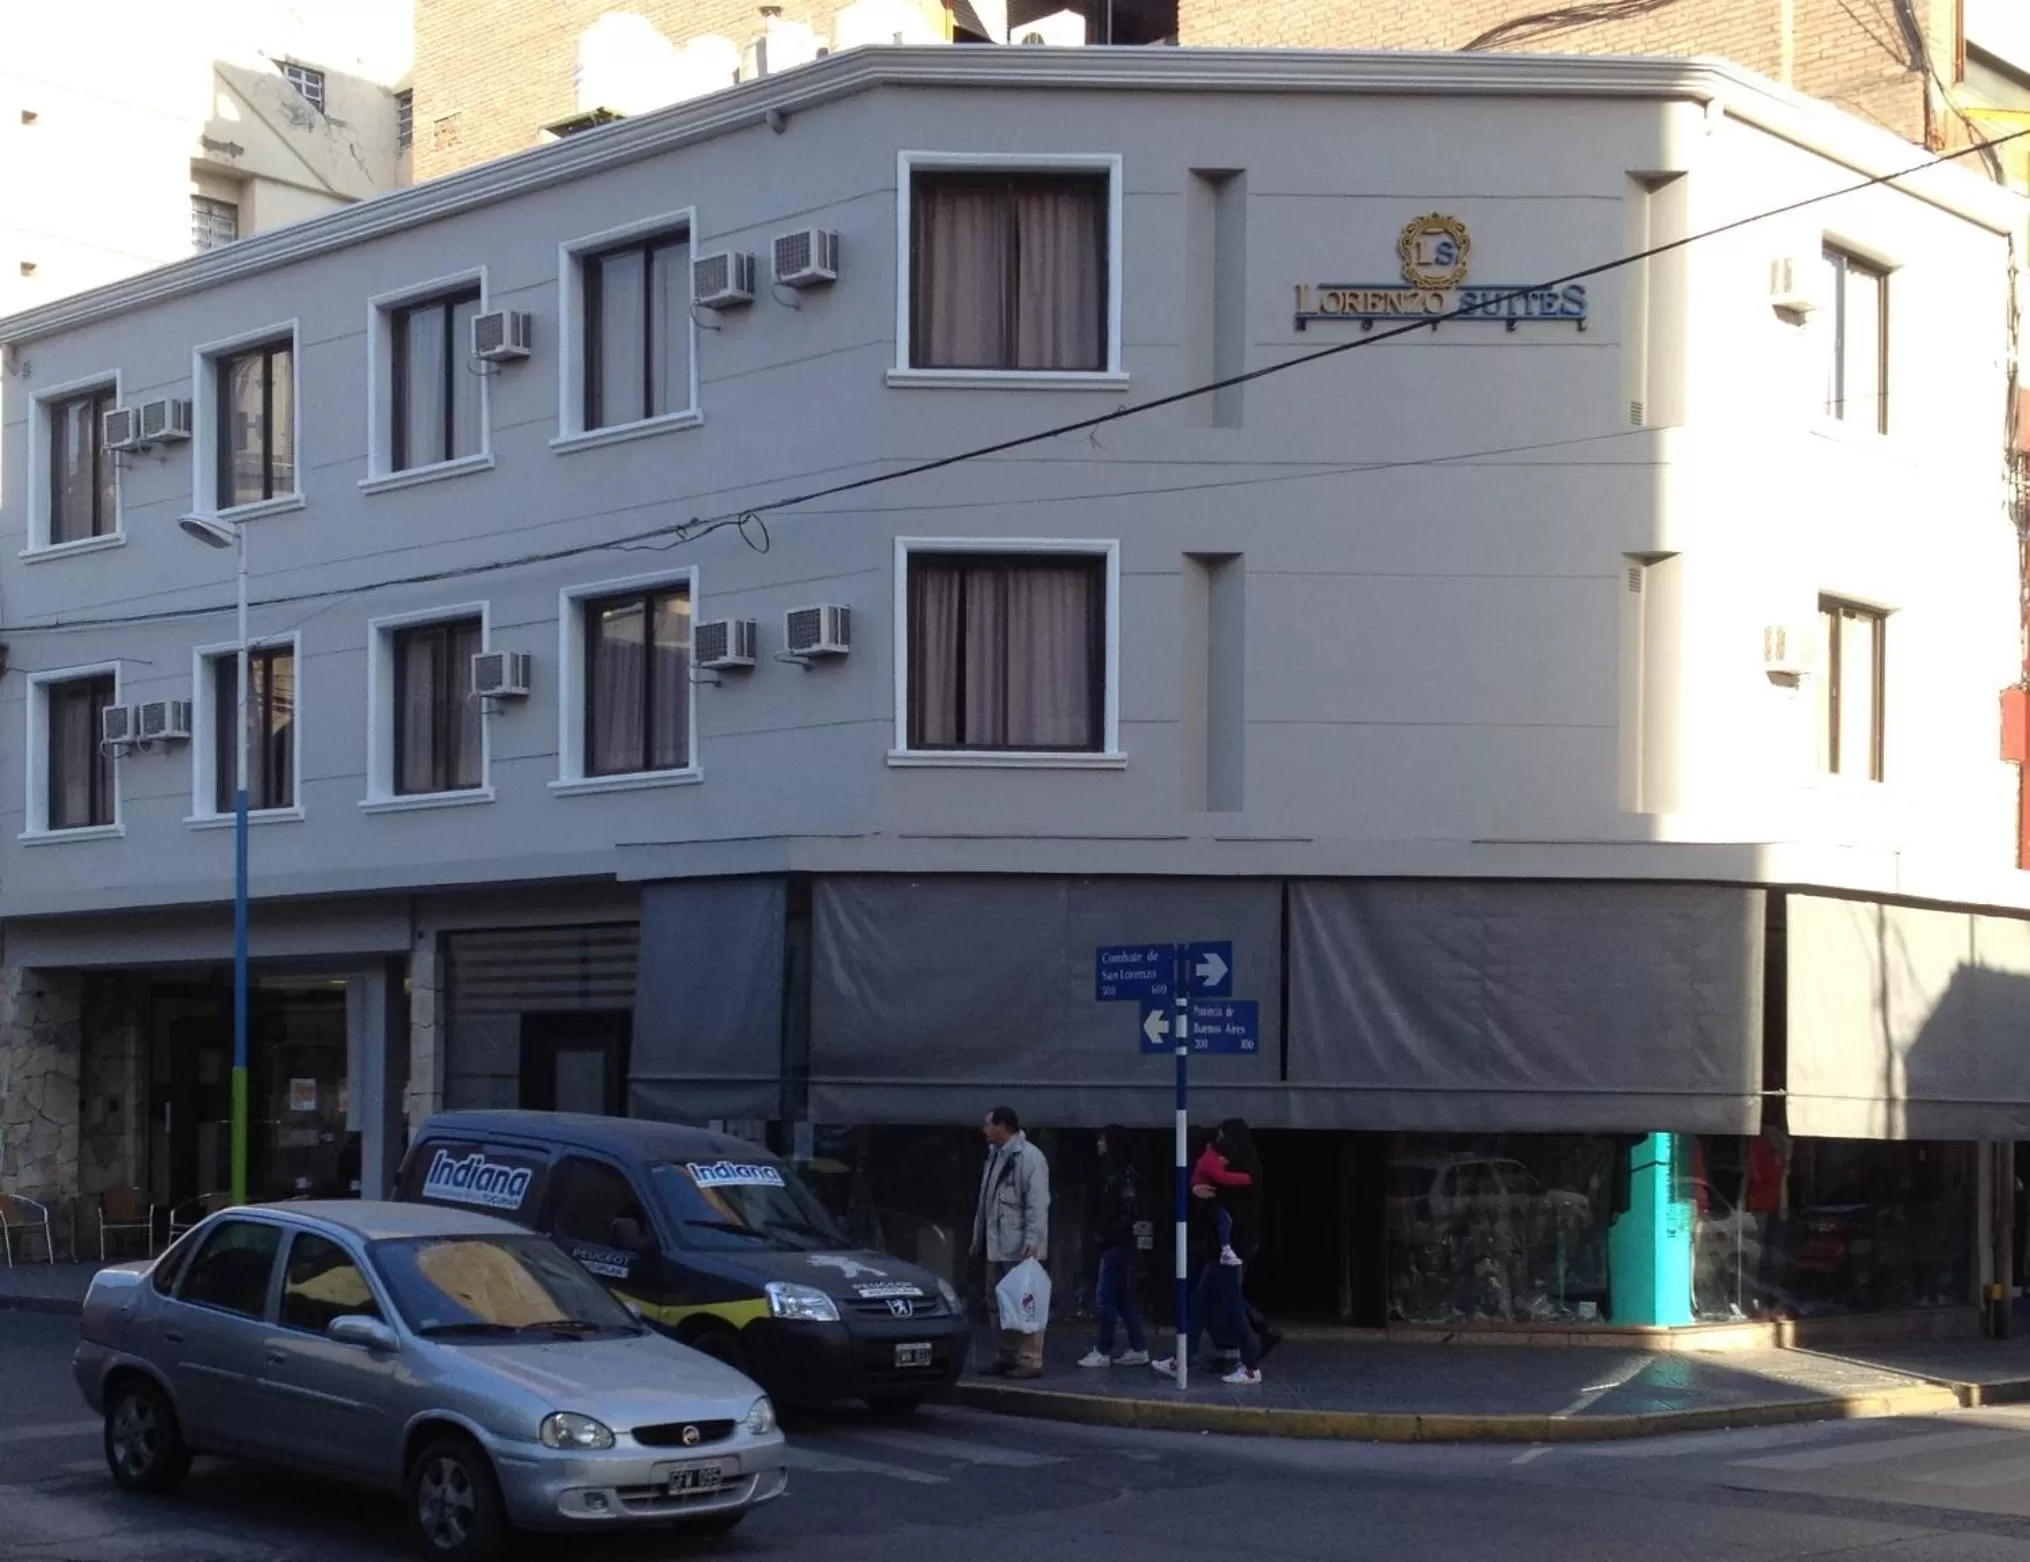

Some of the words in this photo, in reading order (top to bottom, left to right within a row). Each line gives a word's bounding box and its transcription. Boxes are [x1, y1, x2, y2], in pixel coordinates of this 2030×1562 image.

[1294, 283, 1446, 316] LORENZO
[1458, 283, 1588, 317] SUITES
[1102, 950, 1143, 963] Combate
[1147, 948, 1159, 962] de
[1102, 969, 1119, 981] San
[1120, 968, 1157, 981] Lorenzo
[1225, 1022, 1246, 1035] Aires
[427, 1151, 530, 1197] Indiana
[688, 1161, 778, 1182] Indiana
